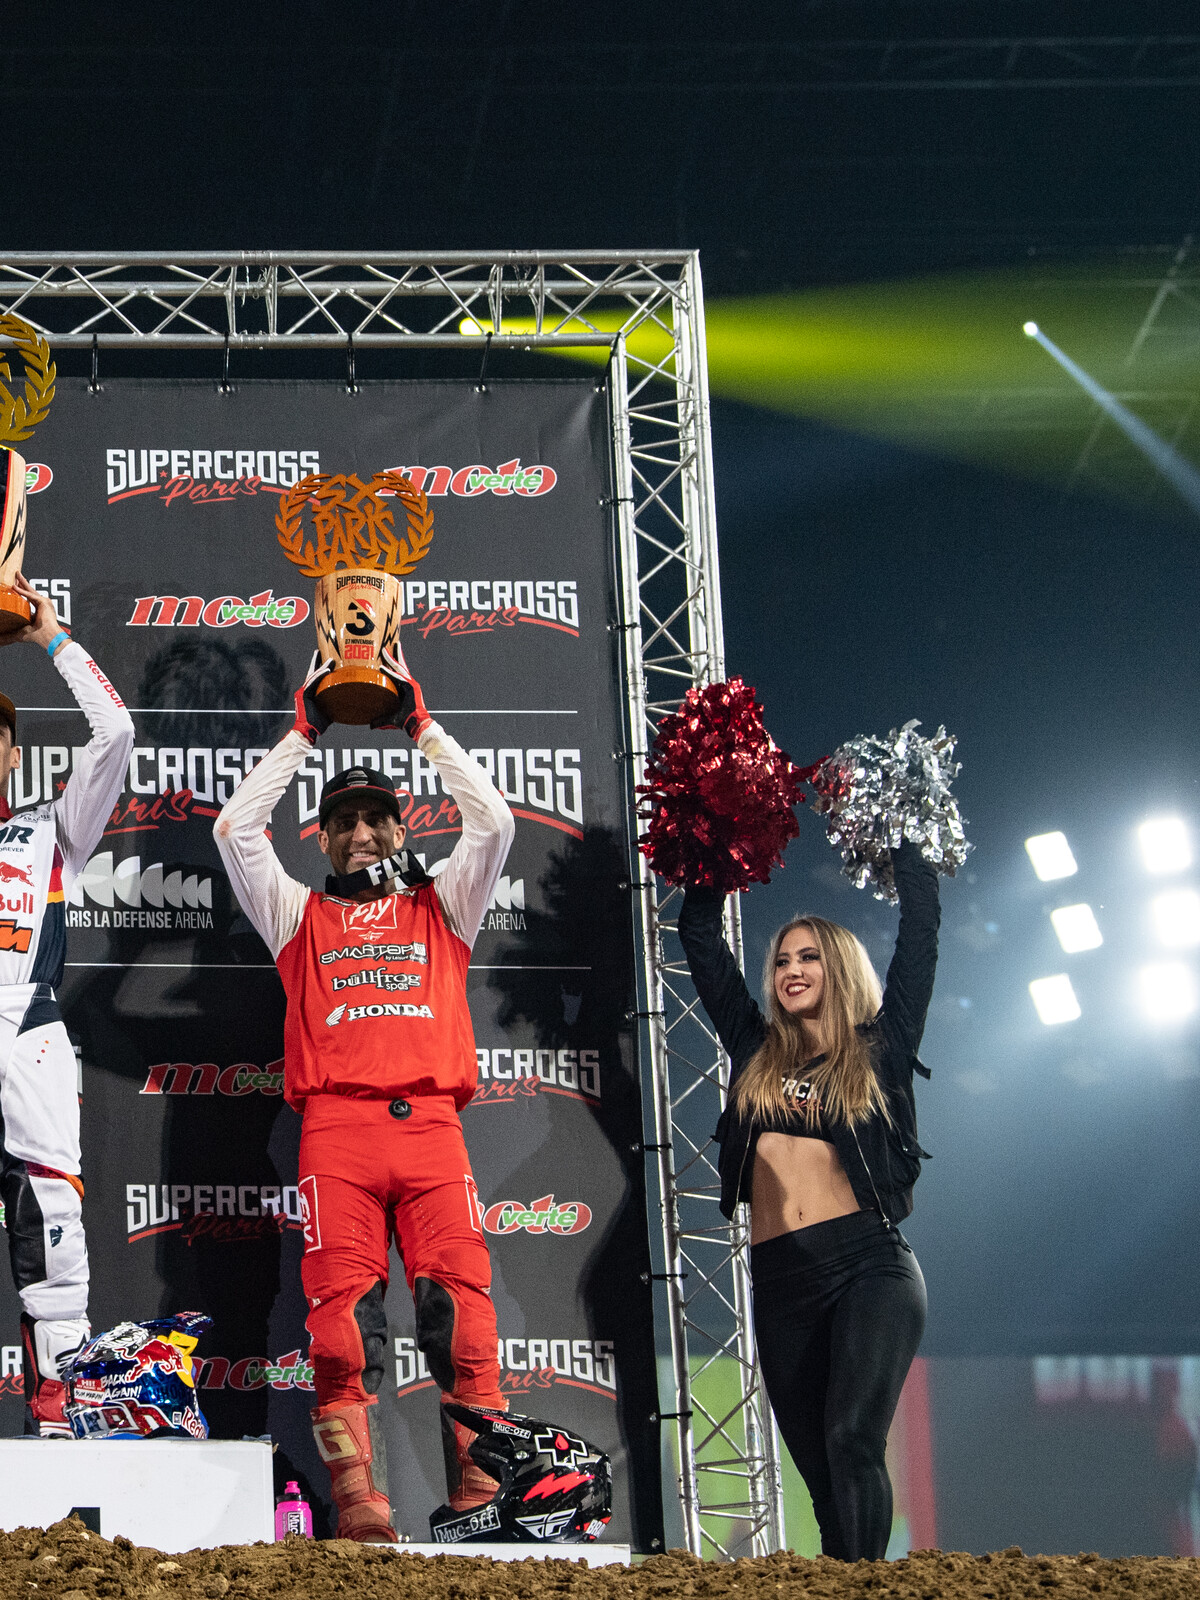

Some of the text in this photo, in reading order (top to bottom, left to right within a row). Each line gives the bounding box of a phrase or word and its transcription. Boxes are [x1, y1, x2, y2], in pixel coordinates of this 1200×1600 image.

[106, 449, 320, 494] SUPERCROSS
[375, 458, 557, 497] moto
[470, 471, 542, 489] verte
[160, 474, 262, 507] Paris
[126, 589, 310, 628] moto
[222, 603, 295, 621] verte
[345, 598, 376, 636] 3
[417, 606, 520, 639] Paris
[85, 660, 126, 708] Red Bull
[366, 850, 410, 887] FLY
[94, 911, 111, 928] LA
[113, 911, 172, 929] DEFENSE
[175, 912, 213, 929] ARENA
[348, 898, 393, 926] FLY
[488, 913, 527, 930] ARENA
[332, 967, 421, 991] bullfrog
[347, 1004, 435, 1021] HONDA
[478, 1194, 592, 1236] oto
[503, 1208, 578, 1226] verte
[104, 1385, 143, 1400] AGAIN!
[437, 1512, 497, 1542] Muc-Off
